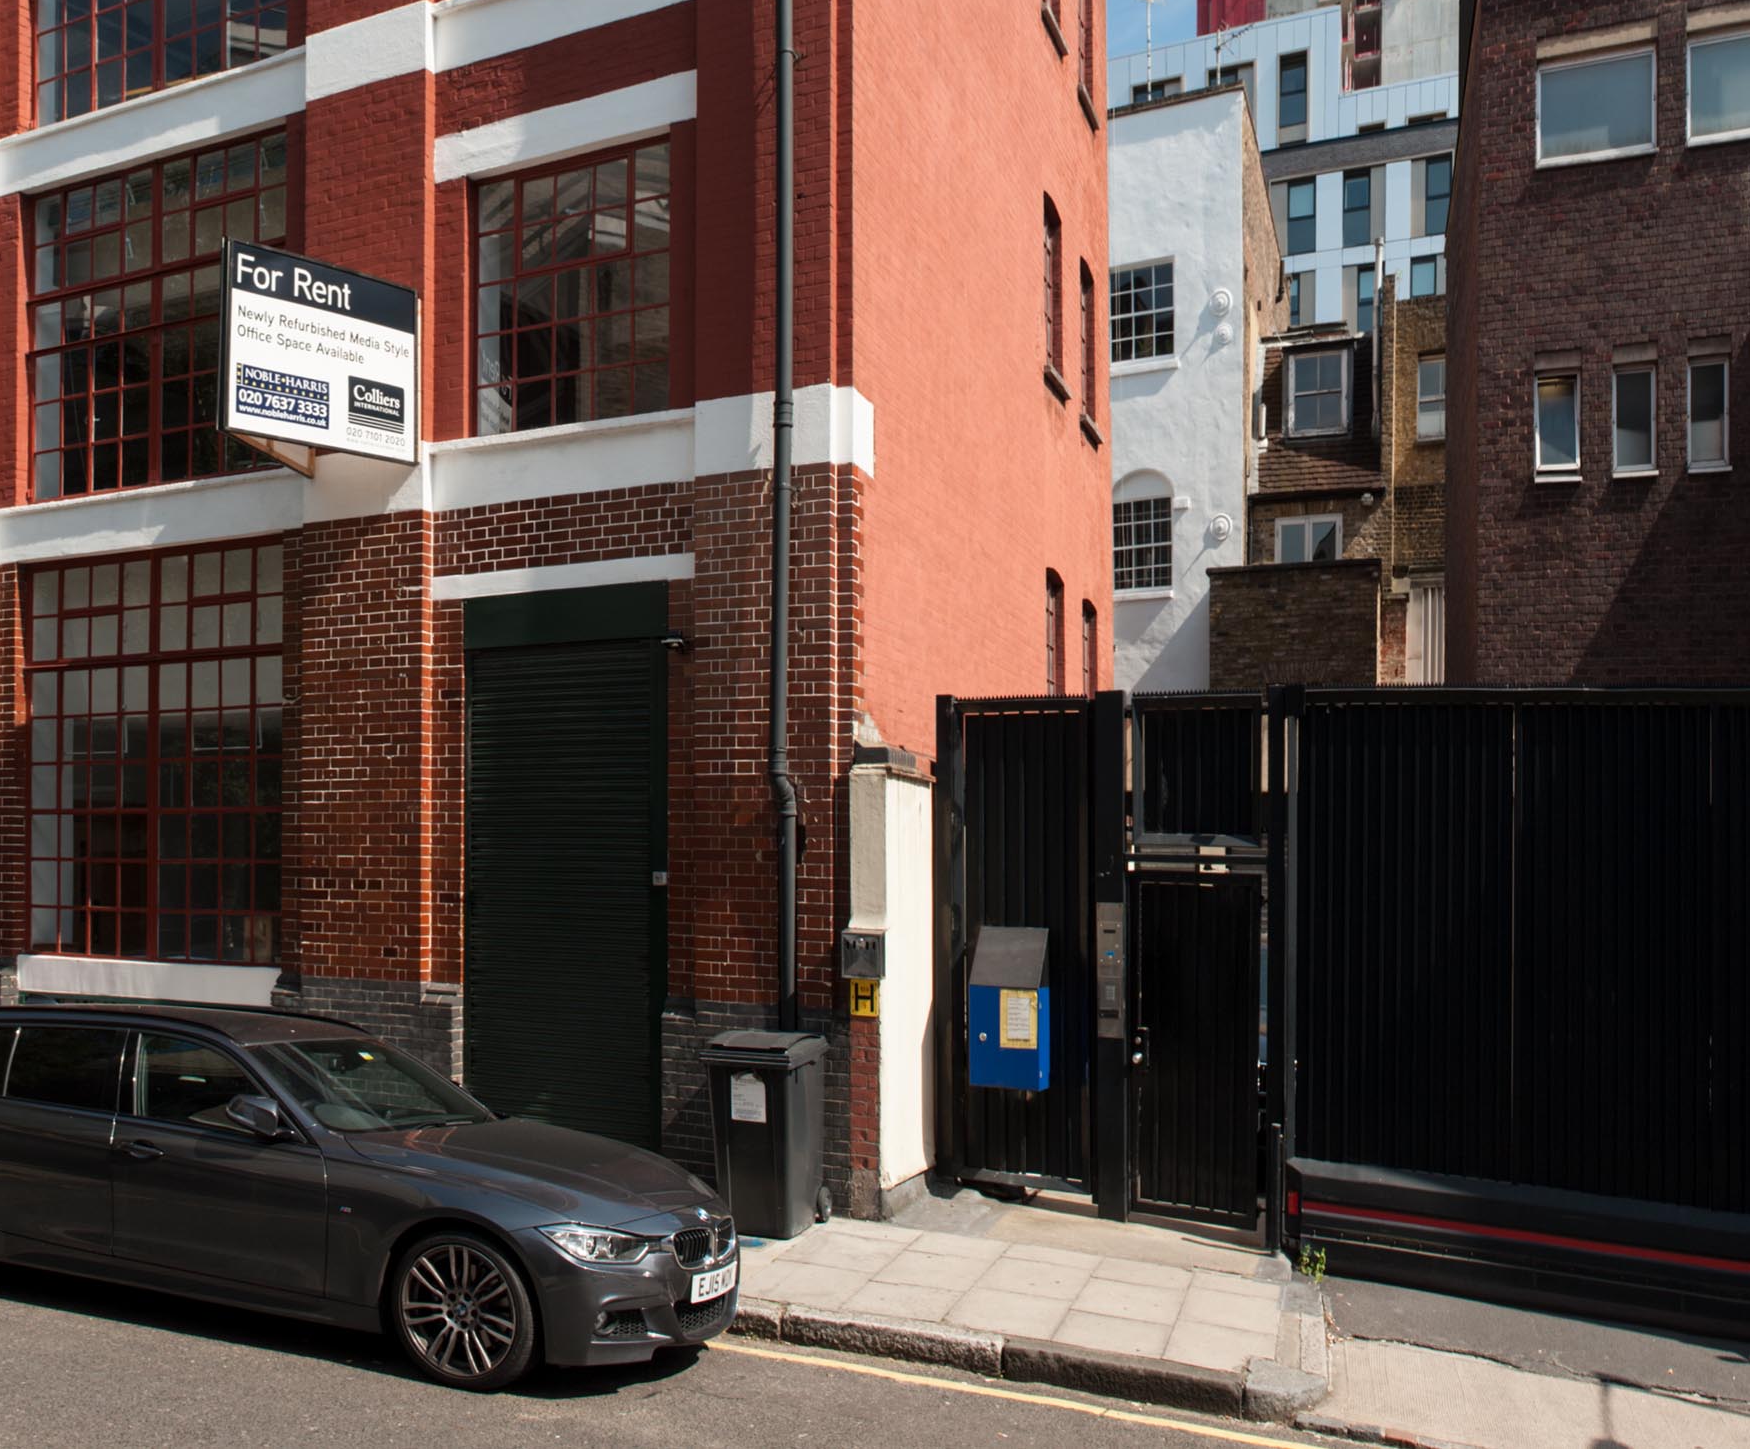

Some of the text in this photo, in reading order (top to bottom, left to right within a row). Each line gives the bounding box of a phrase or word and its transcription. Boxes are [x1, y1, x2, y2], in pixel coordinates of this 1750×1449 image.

[236, 252, 352, 310] For Rent
[237, 304, 410, 358] Newly Refurbished Media Style
[237, 324, 365, 364] Office Space Available
[238, 388, 327, 418] 020 7637 3333
[353, 384, 401, 409] Colliers
[353, 400, 401, 417] INTERNATIONAL
[238, 405, 327, 427] www.nobleharris.co.uk
[346, 426, 363, 438] 020
[365, 429, 382, 442] 7101
[385, 434, 406, 447] 2020
[854, 982, 874, 1012] H
